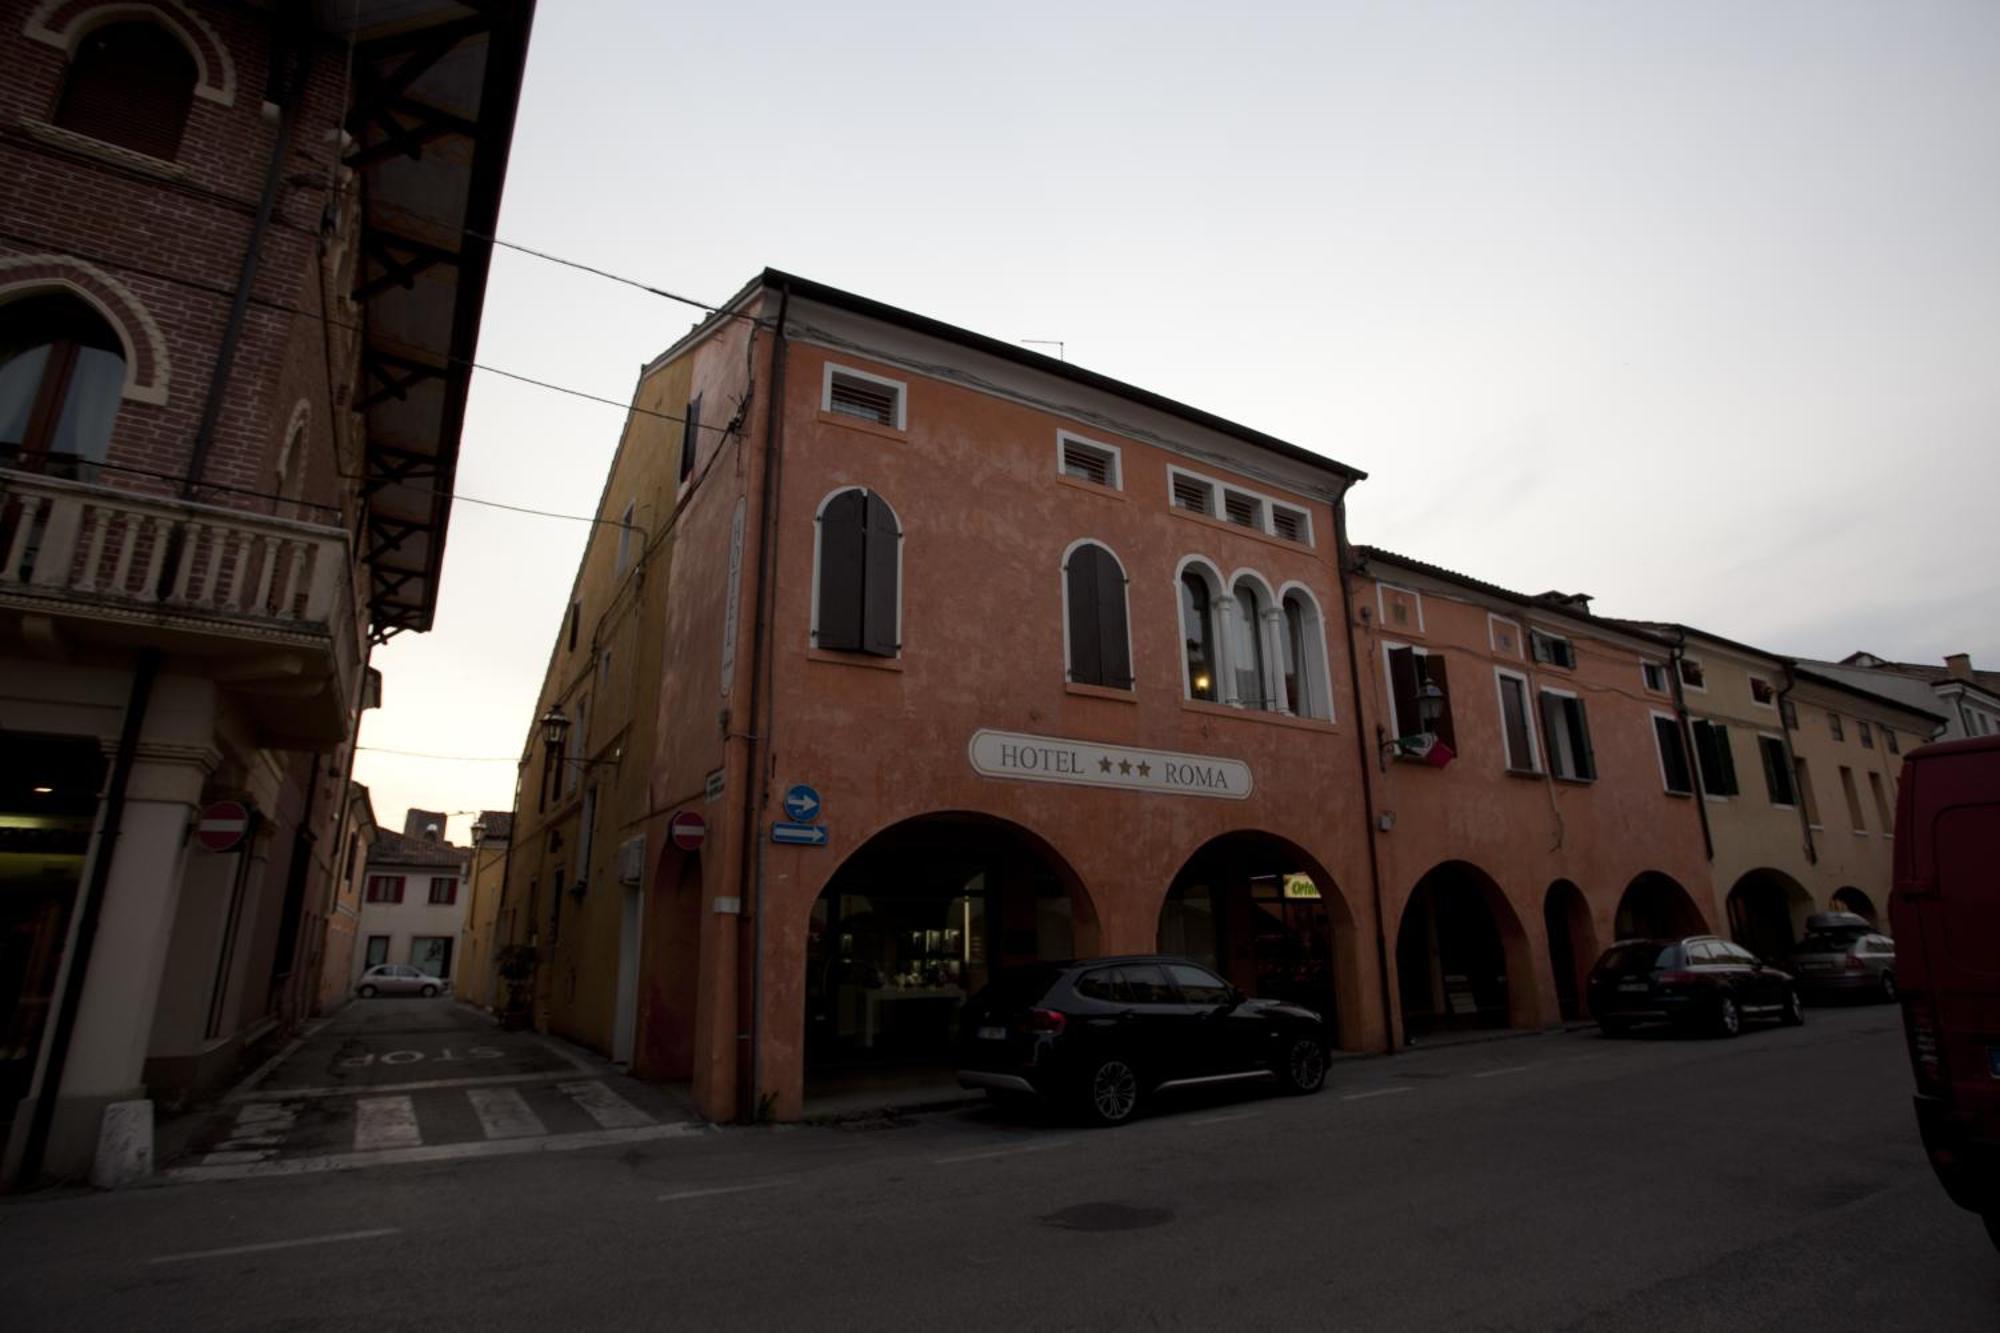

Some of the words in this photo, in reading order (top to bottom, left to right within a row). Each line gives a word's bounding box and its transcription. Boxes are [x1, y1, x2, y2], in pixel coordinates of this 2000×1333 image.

[1000, 744, 1084, 775] HOTEL
[1165, 762, 1228, 789] ROMA
[339, 1046, 505, 1067] STOP
